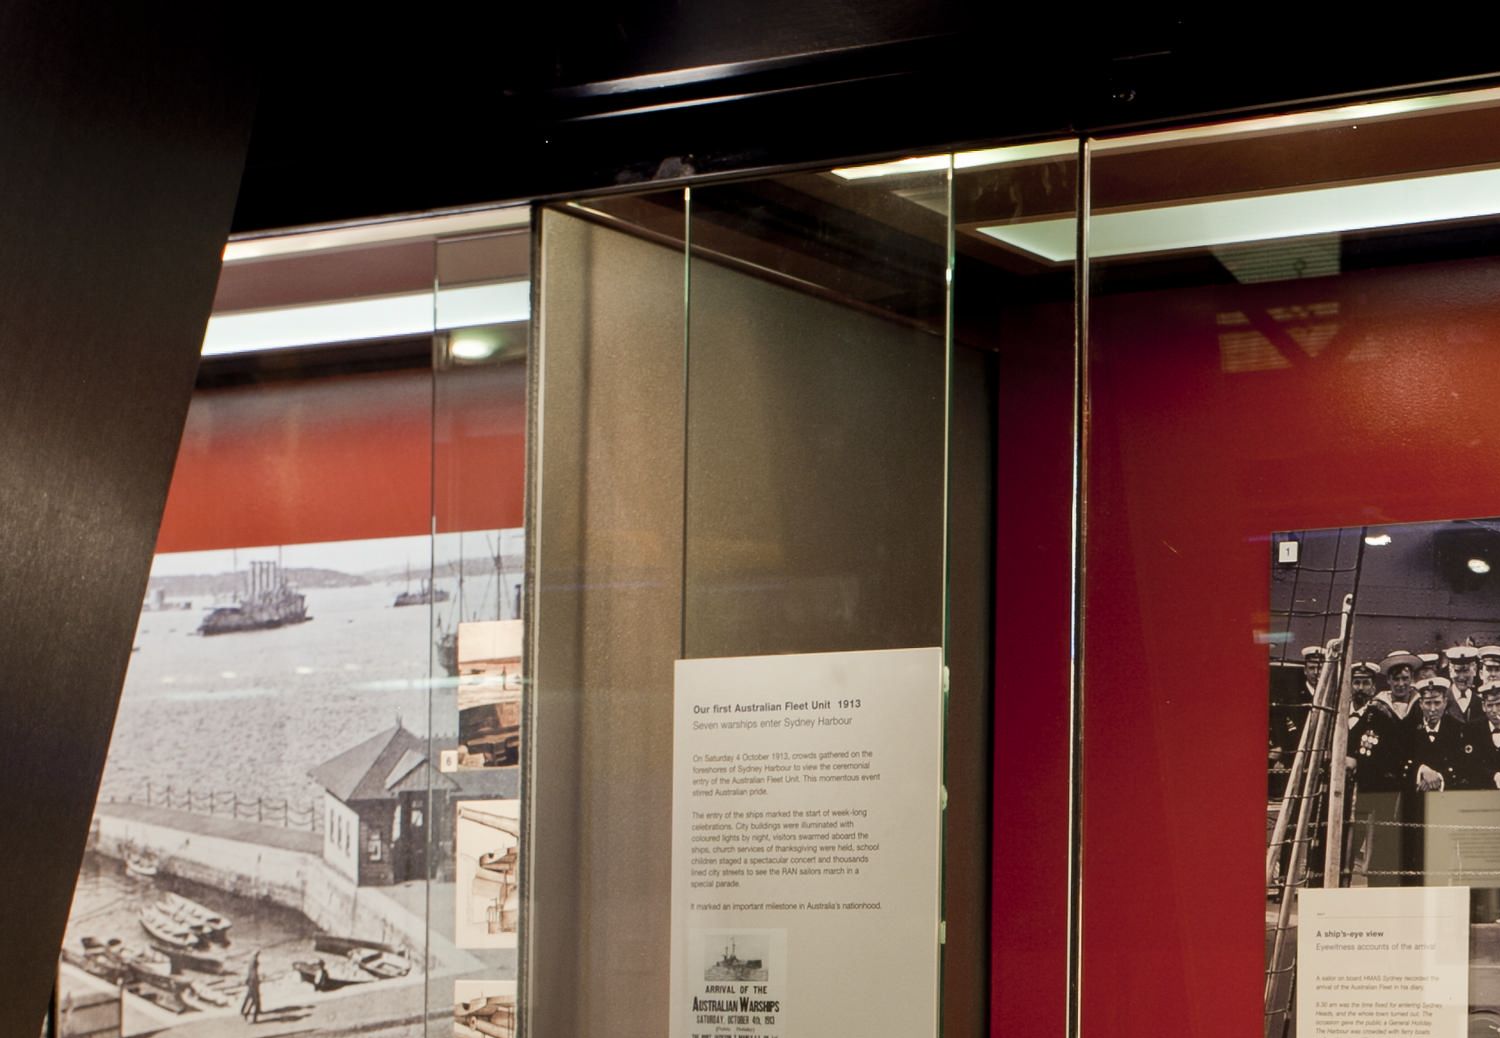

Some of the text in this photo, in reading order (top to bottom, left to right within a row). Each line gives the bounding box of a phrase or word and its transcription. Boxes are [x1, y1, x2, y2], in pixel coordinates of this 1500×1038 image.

[693, 700, 860, 713] Our first Australian Fleet Unit 1913
[693, 717, 852, 730] Seven warships enter Sydney Harbour
[693, 754, 702, 762] On
[705, 754, 733, 763] Saturday
[736, 753, 740, 761] 4
[743, 753, 770, 761] October
[772, 752, 790, 761] 1913,
[819, 751, 849, 761] gathered
[862, 750, 872, 758] the
[738, 765, 762, 774] Sydney
[765, 764, 790, 772] Harbour
[803, 763, 817, 771] view
[833, 762, 870, 770] ceremonial
[693, 777, 709, 787] entry
[732, 776, 764, 784] Australian
[767, 775, 783, 783] Fleet
[819, 774, 859, 782] momentous
[861, 773, 880, 781] event
[715, 788, 748, 796] Australian
[707, 811, 722, 821] entry
[746, 811, 763, 820] ships
[766, 810, 790, 818] marked
[696, 902, 720, 910] marked
[733, 902, 763, 912] important
[766, 902, 797, 910] milestone
[799, 902, 805, 910] in
[807, 902, 840, 910] Australia's
[1324, 929, 1363, 938] ship's-eye
[1316, 943, 1355, 951] Eyewitness
[705, 985, 767, 994] ARRIVAL OF THE
[728, 1016, 749, 1024] OCTOBER
[764, 1016, 775, 1024] 1913
